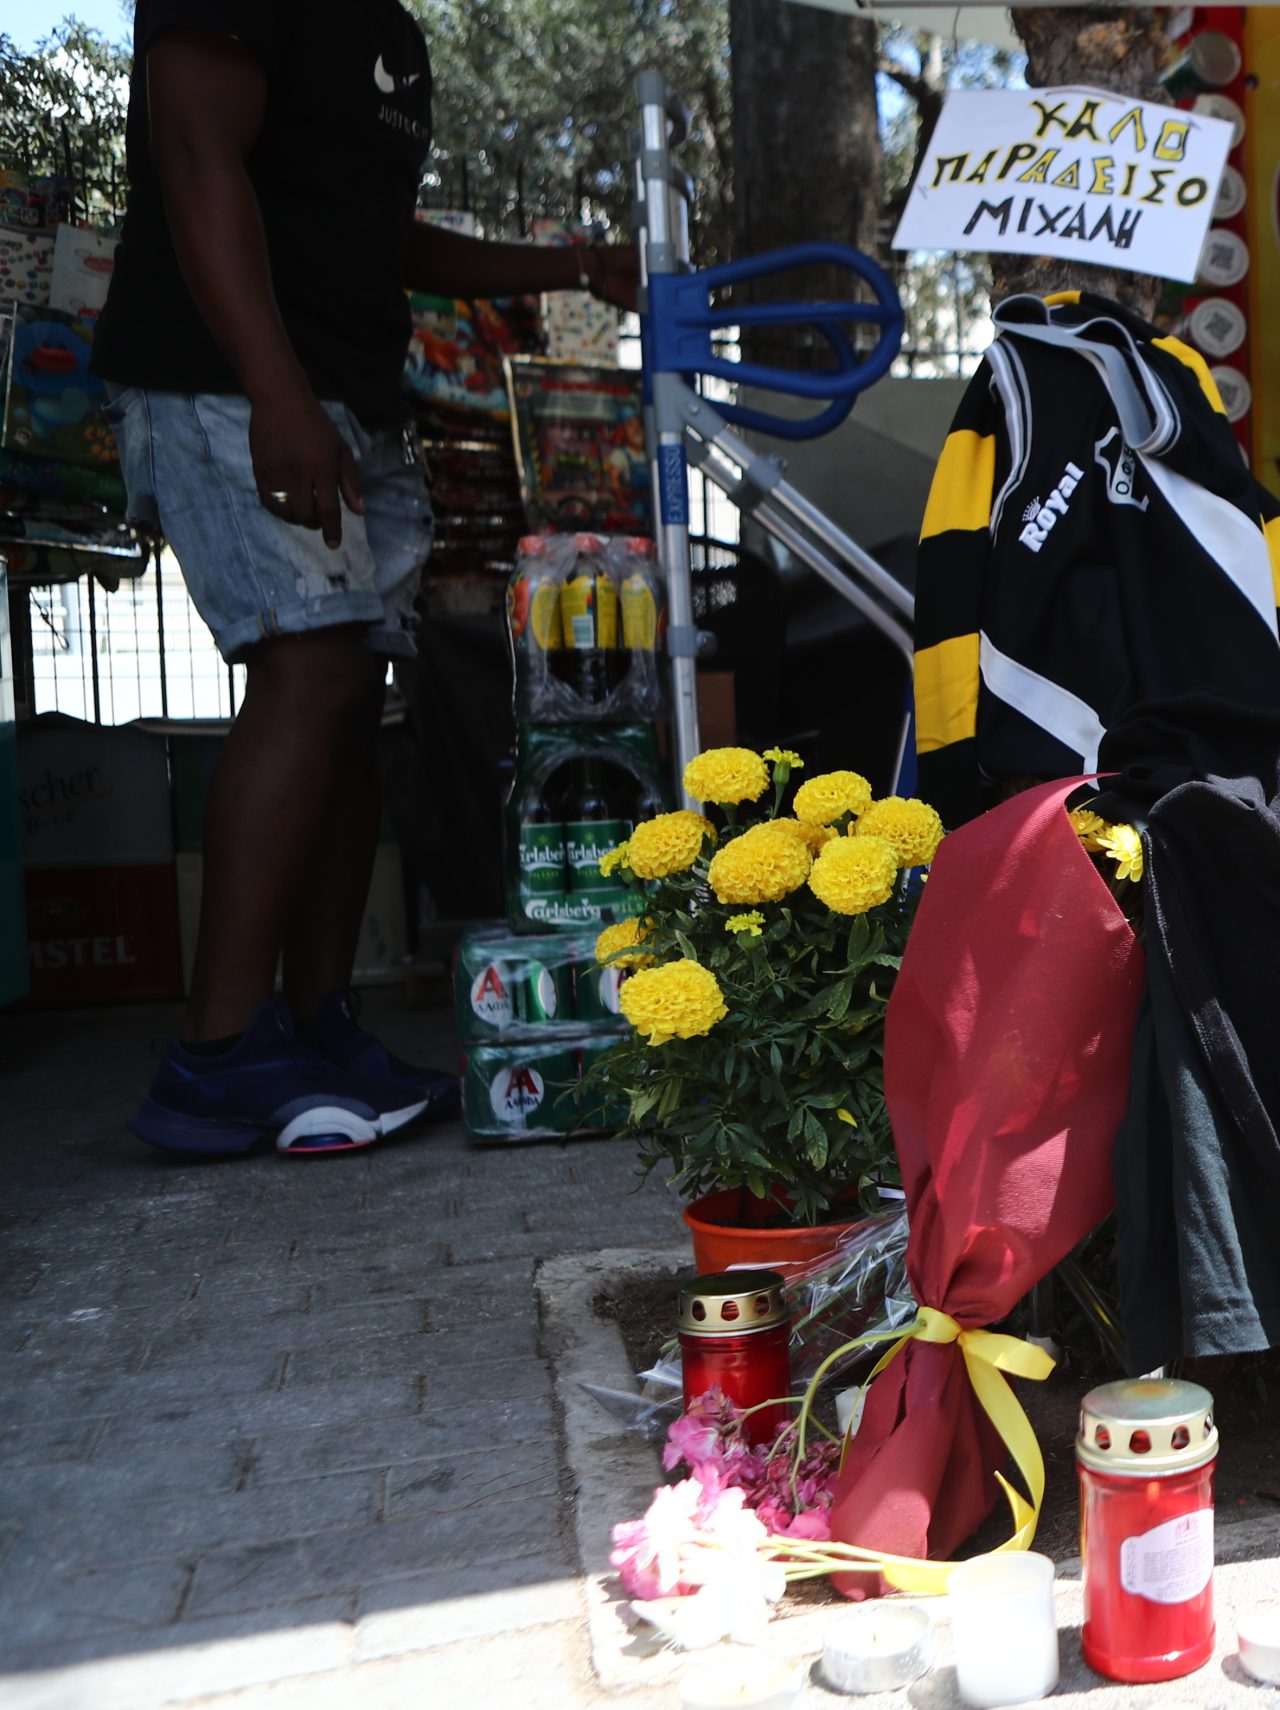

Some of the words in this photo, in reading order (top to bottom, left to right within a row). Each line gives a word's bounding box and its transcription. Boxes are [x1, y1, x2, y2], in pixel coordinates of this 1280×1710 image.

[929, 142, 1209, 207] ΠΑΡΑΔΕΙΣΟ
[961, 196, 1144, 250] ΜΙΧΑΛΗ
[1018, 461, 1085, 553] Royal
[525, 898, 601, 924] Carlsberg
